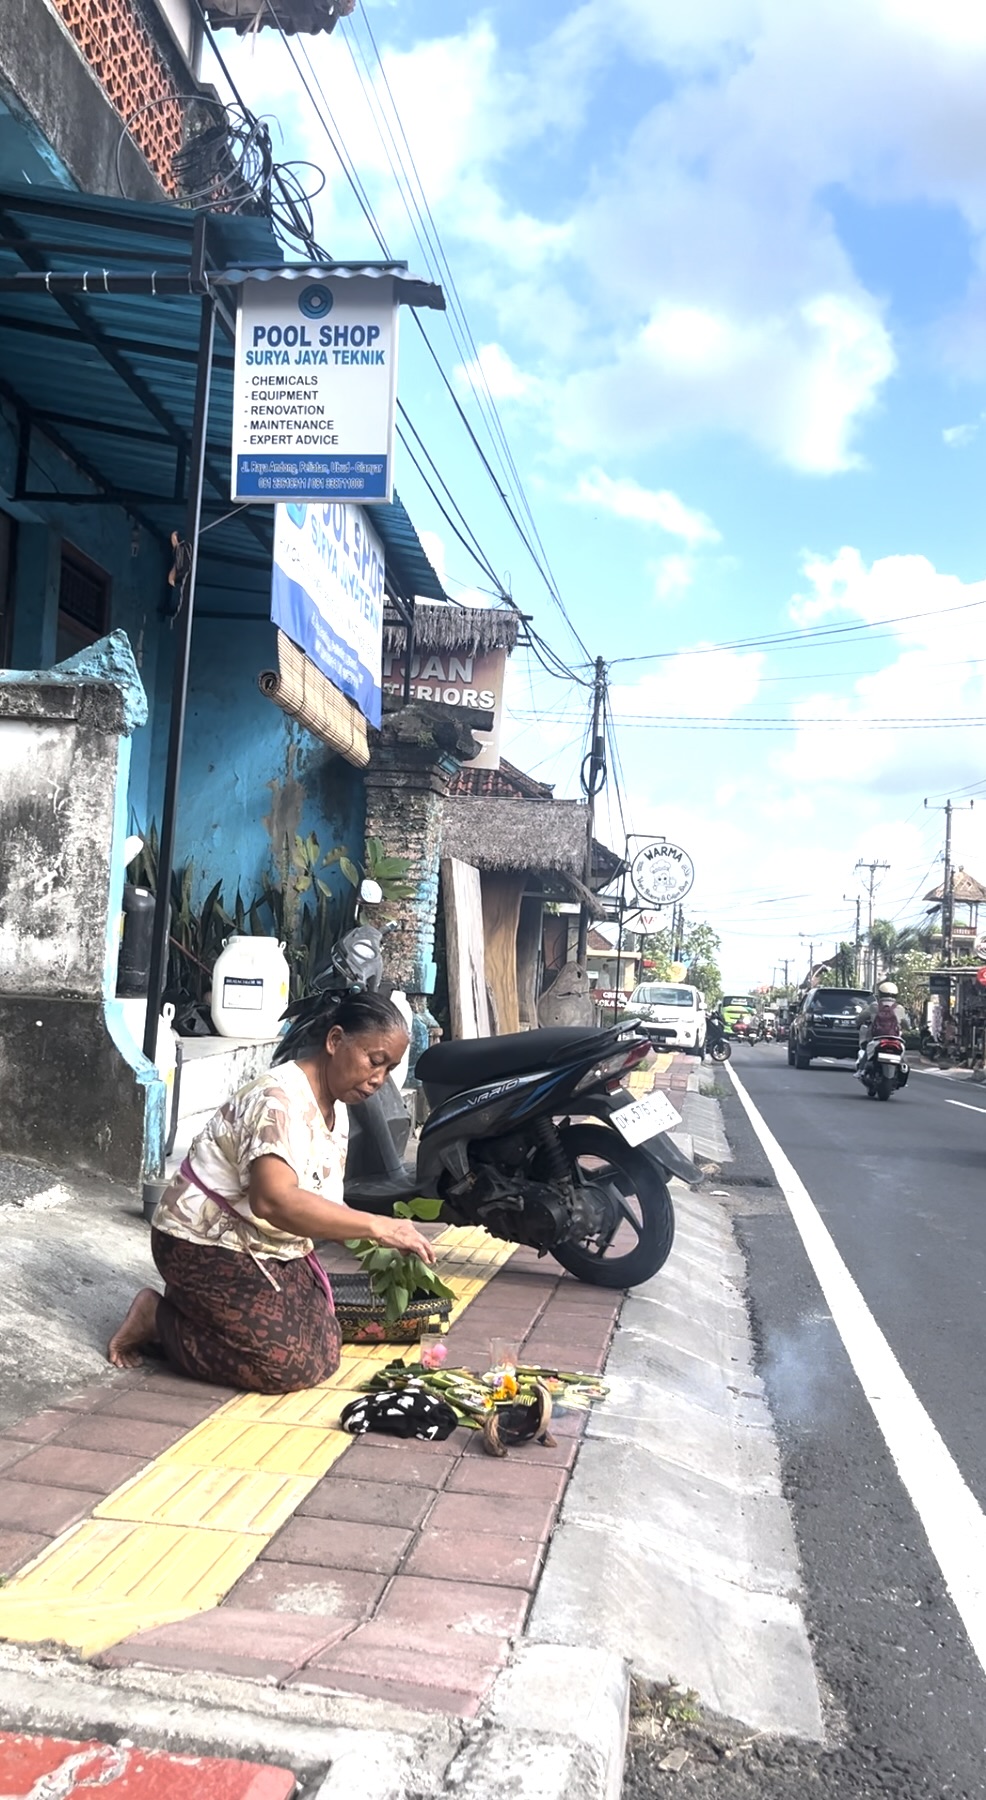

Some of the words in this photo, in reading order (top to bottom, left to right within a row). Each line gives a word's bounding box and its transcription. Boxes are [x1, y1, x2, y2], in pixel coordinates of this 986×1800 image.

[253, 325, 312, 347] POOL
[319, 325, 380, 347] SHOP
[245, 350, 290, 365] SURYA
[294, 350, 328, 365] JAYA
[333, 350, 385, 365] TEKNIK
[251, 376, 318, 386] CHEMICALS
[251, 391, 319, 401] EQUIPMENT
[250, 405, 325, 415] RENOVATION
[250, 420, 334, 430] MAINTENANCE
[250, 435, 293, 445] EXPERT
[295, 435, 339, 445] ADVICE
[330, 461, 351, 473] Ubud
[643, 846, 683, 863] WARMA
[467, 1078, 519, 1105] VARIO
